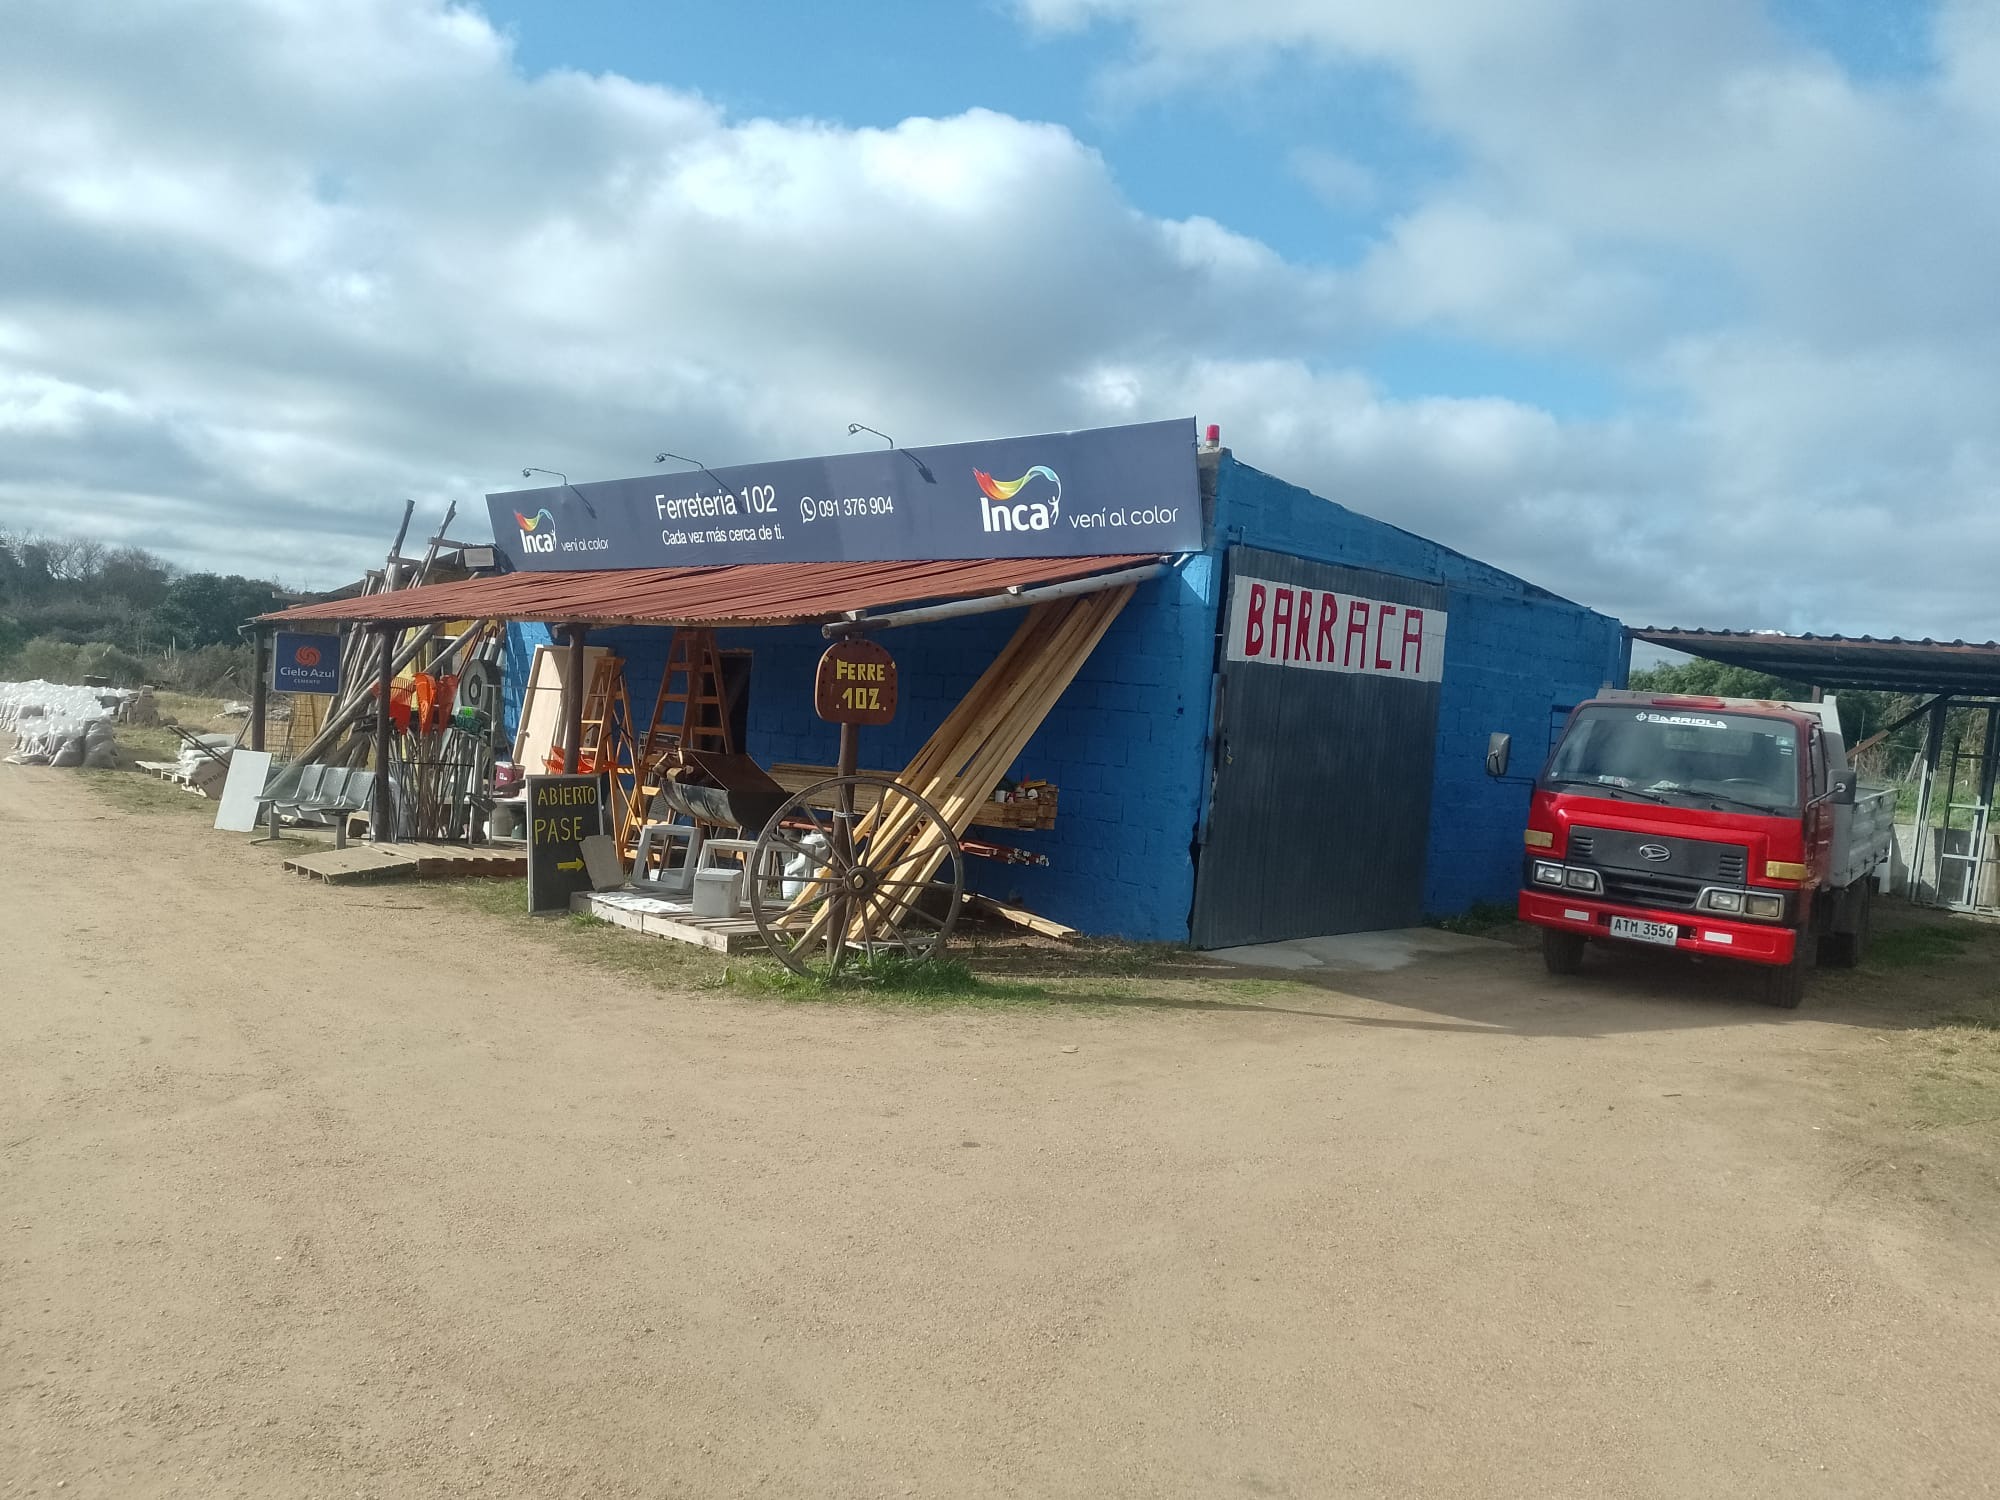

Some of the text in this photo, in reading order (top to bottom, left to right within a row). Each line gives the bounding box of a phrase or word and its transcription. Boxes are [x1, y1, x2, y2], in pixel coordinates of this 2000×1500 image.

[655, 484, 778, 521] Ferreteria 102
[818, 495, 894, 518] 091 376 904
[980, 497, 1179, 533] Inca vení al color
[519, 528, 554, 554] Inca
[587, 537, 609, 550] color
[662, 522, 785, 546] Cada vez más cerca de ti.
[1245, 583, 1424, 674] BARRACA
[280, 666, 335, 678] Cielo Azul
[836, 658, 886, 682] FERRE
[534, 816, 583, 845] PASE
[1614, 918, 1639, 933] ATM
[1642, 922, 1674, 939] 3556
